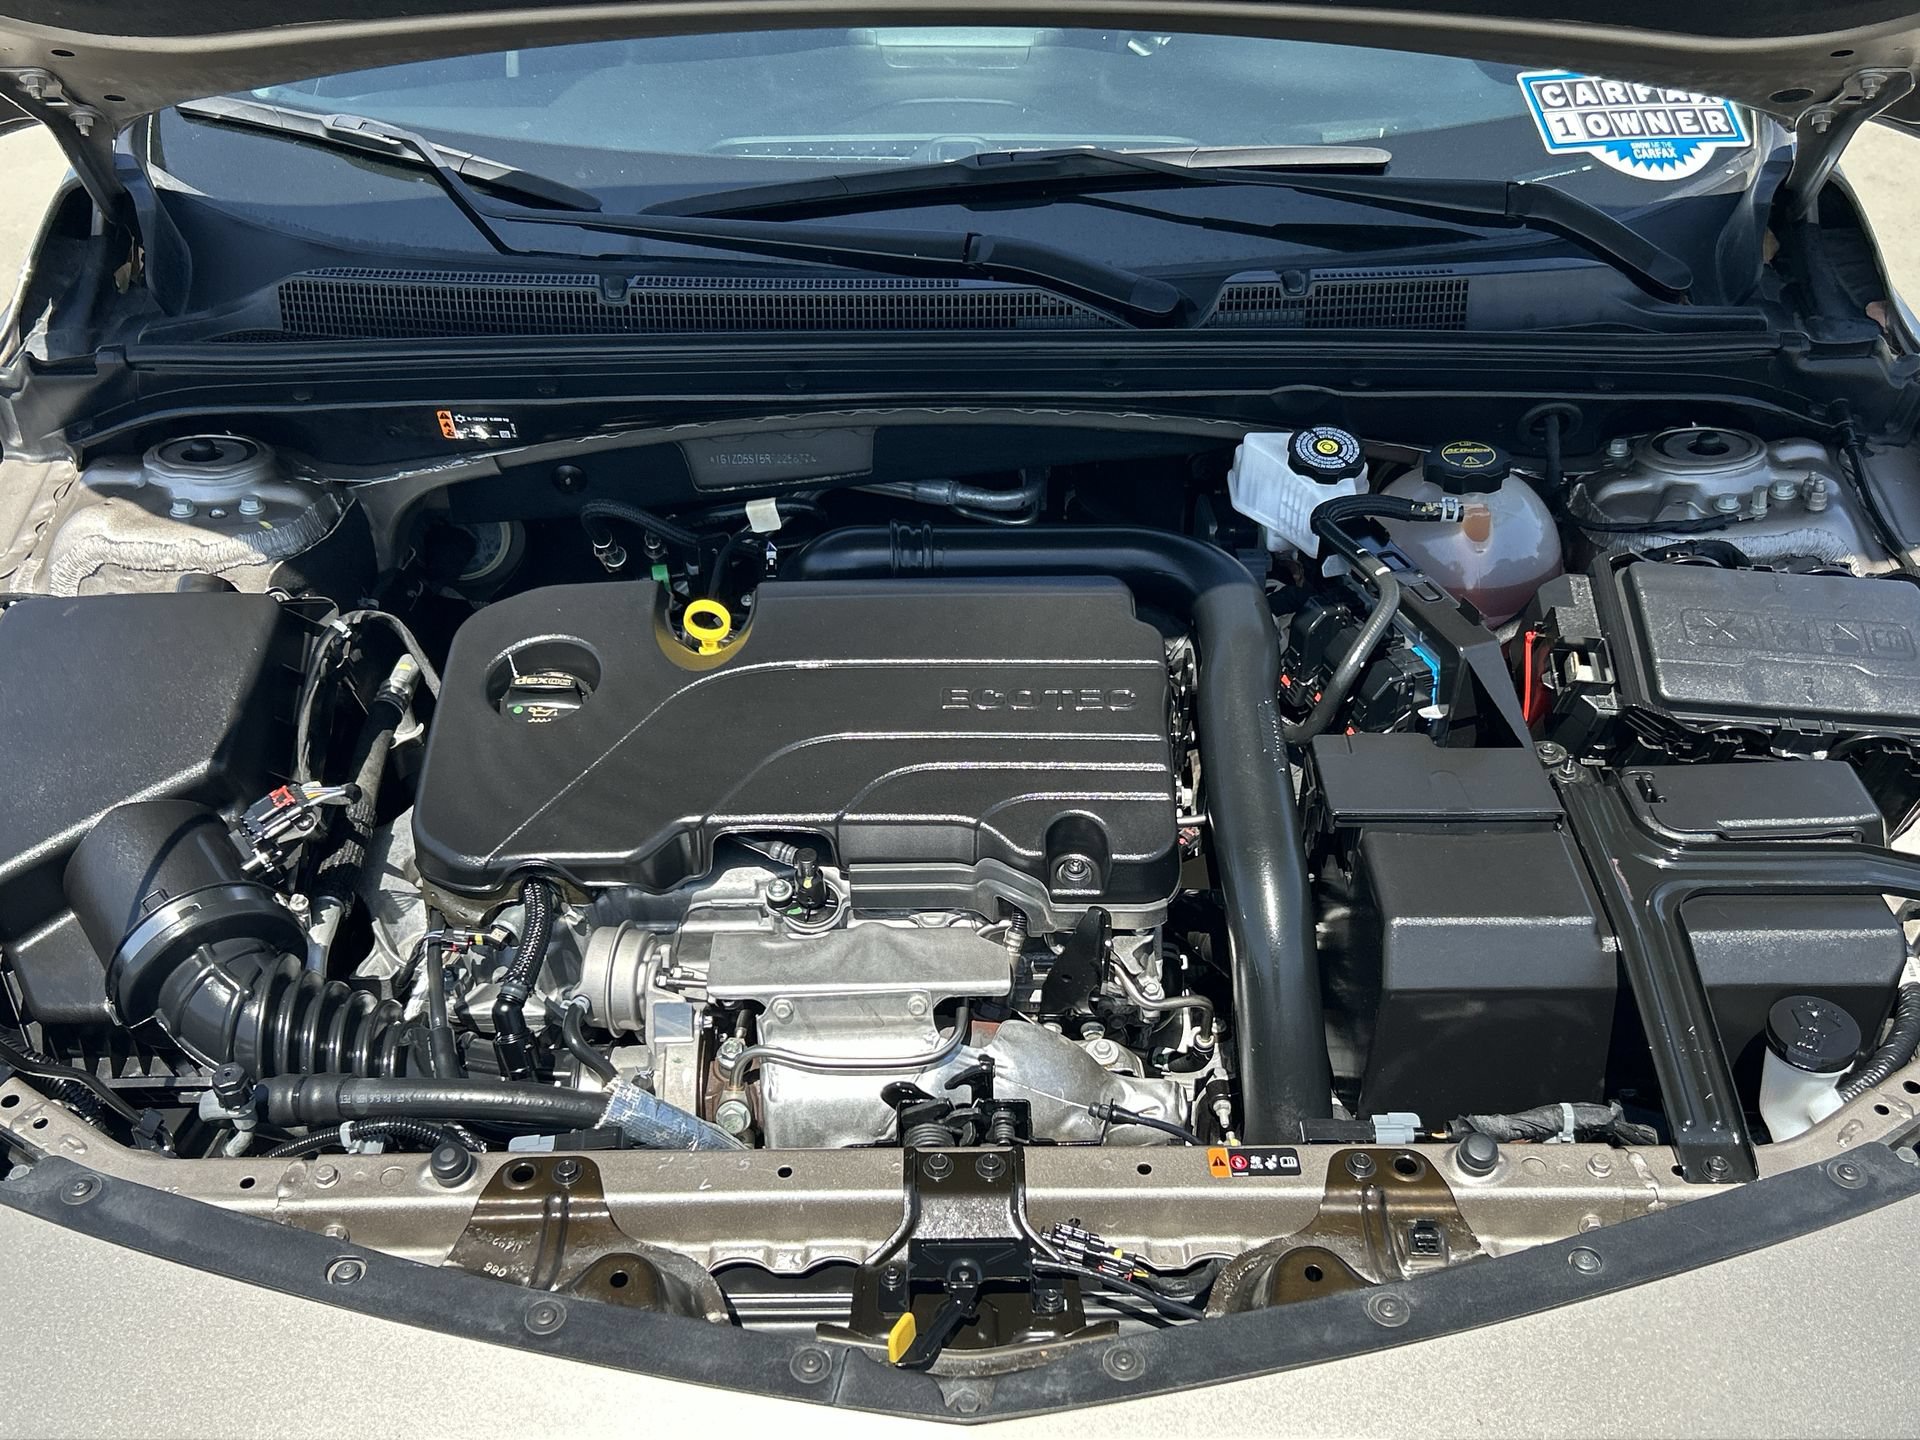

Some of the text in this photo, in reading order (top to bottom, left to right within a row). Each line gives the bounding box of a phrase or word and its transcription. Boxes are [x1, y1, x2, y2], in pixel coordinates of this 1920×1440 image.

[1554, 110, 1730, 137] 1 OWNER
[1633, 148, 1677, 160] CARFAX
[514, 676, 572, 685] dexos
[940, 687, 1137, 711] ECOTEC
